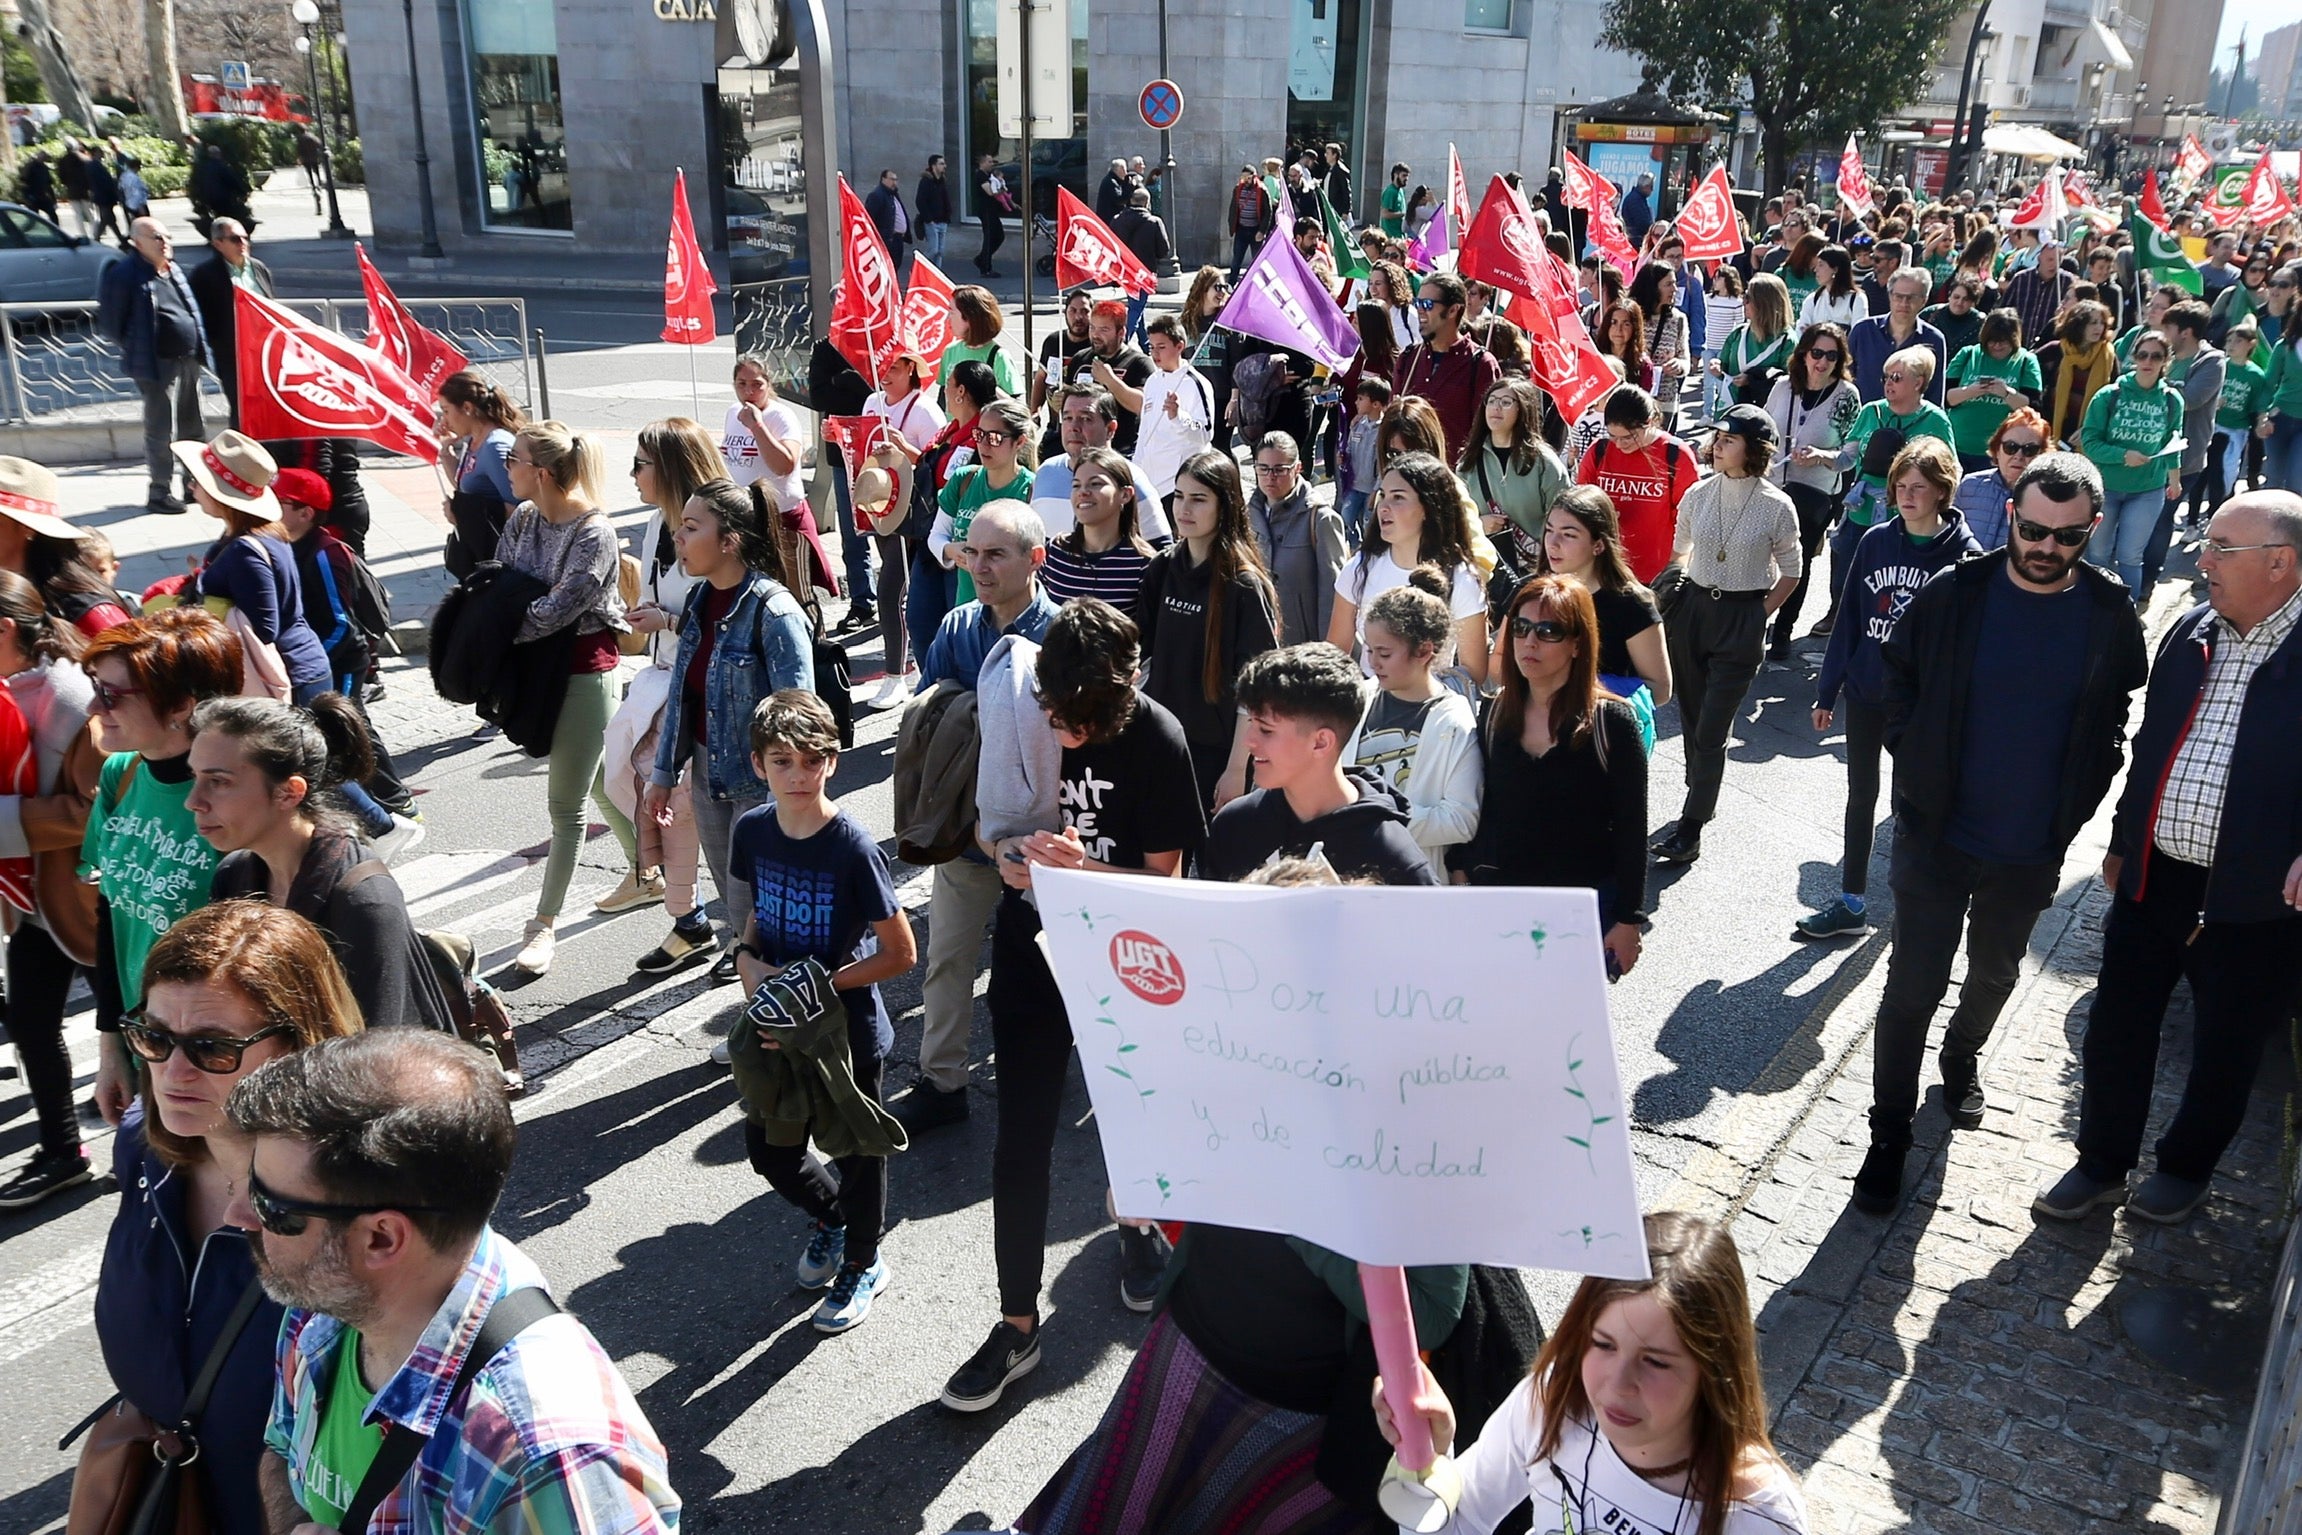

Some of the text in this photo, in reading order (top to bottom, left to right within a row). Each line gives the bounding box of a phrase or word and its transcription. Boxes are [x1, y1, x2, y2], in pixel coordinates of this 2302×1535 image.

[653, 0, 717, 21] CAJA
[1598, 476, 1664, 498] THANKS
[1165, 596, 1202, 613] KAOTIKO
[756, 888, 833, 925] JUST DO IT
[1116, 936, 1171, 977] UGT
[1203, 939, 1469, 1024] Por una
[1184, 1022, 1511, 1105] educación pública
[1192, 1099, 1291, 1151] y de
[1324, 1128, 1488, 1178] calidad
